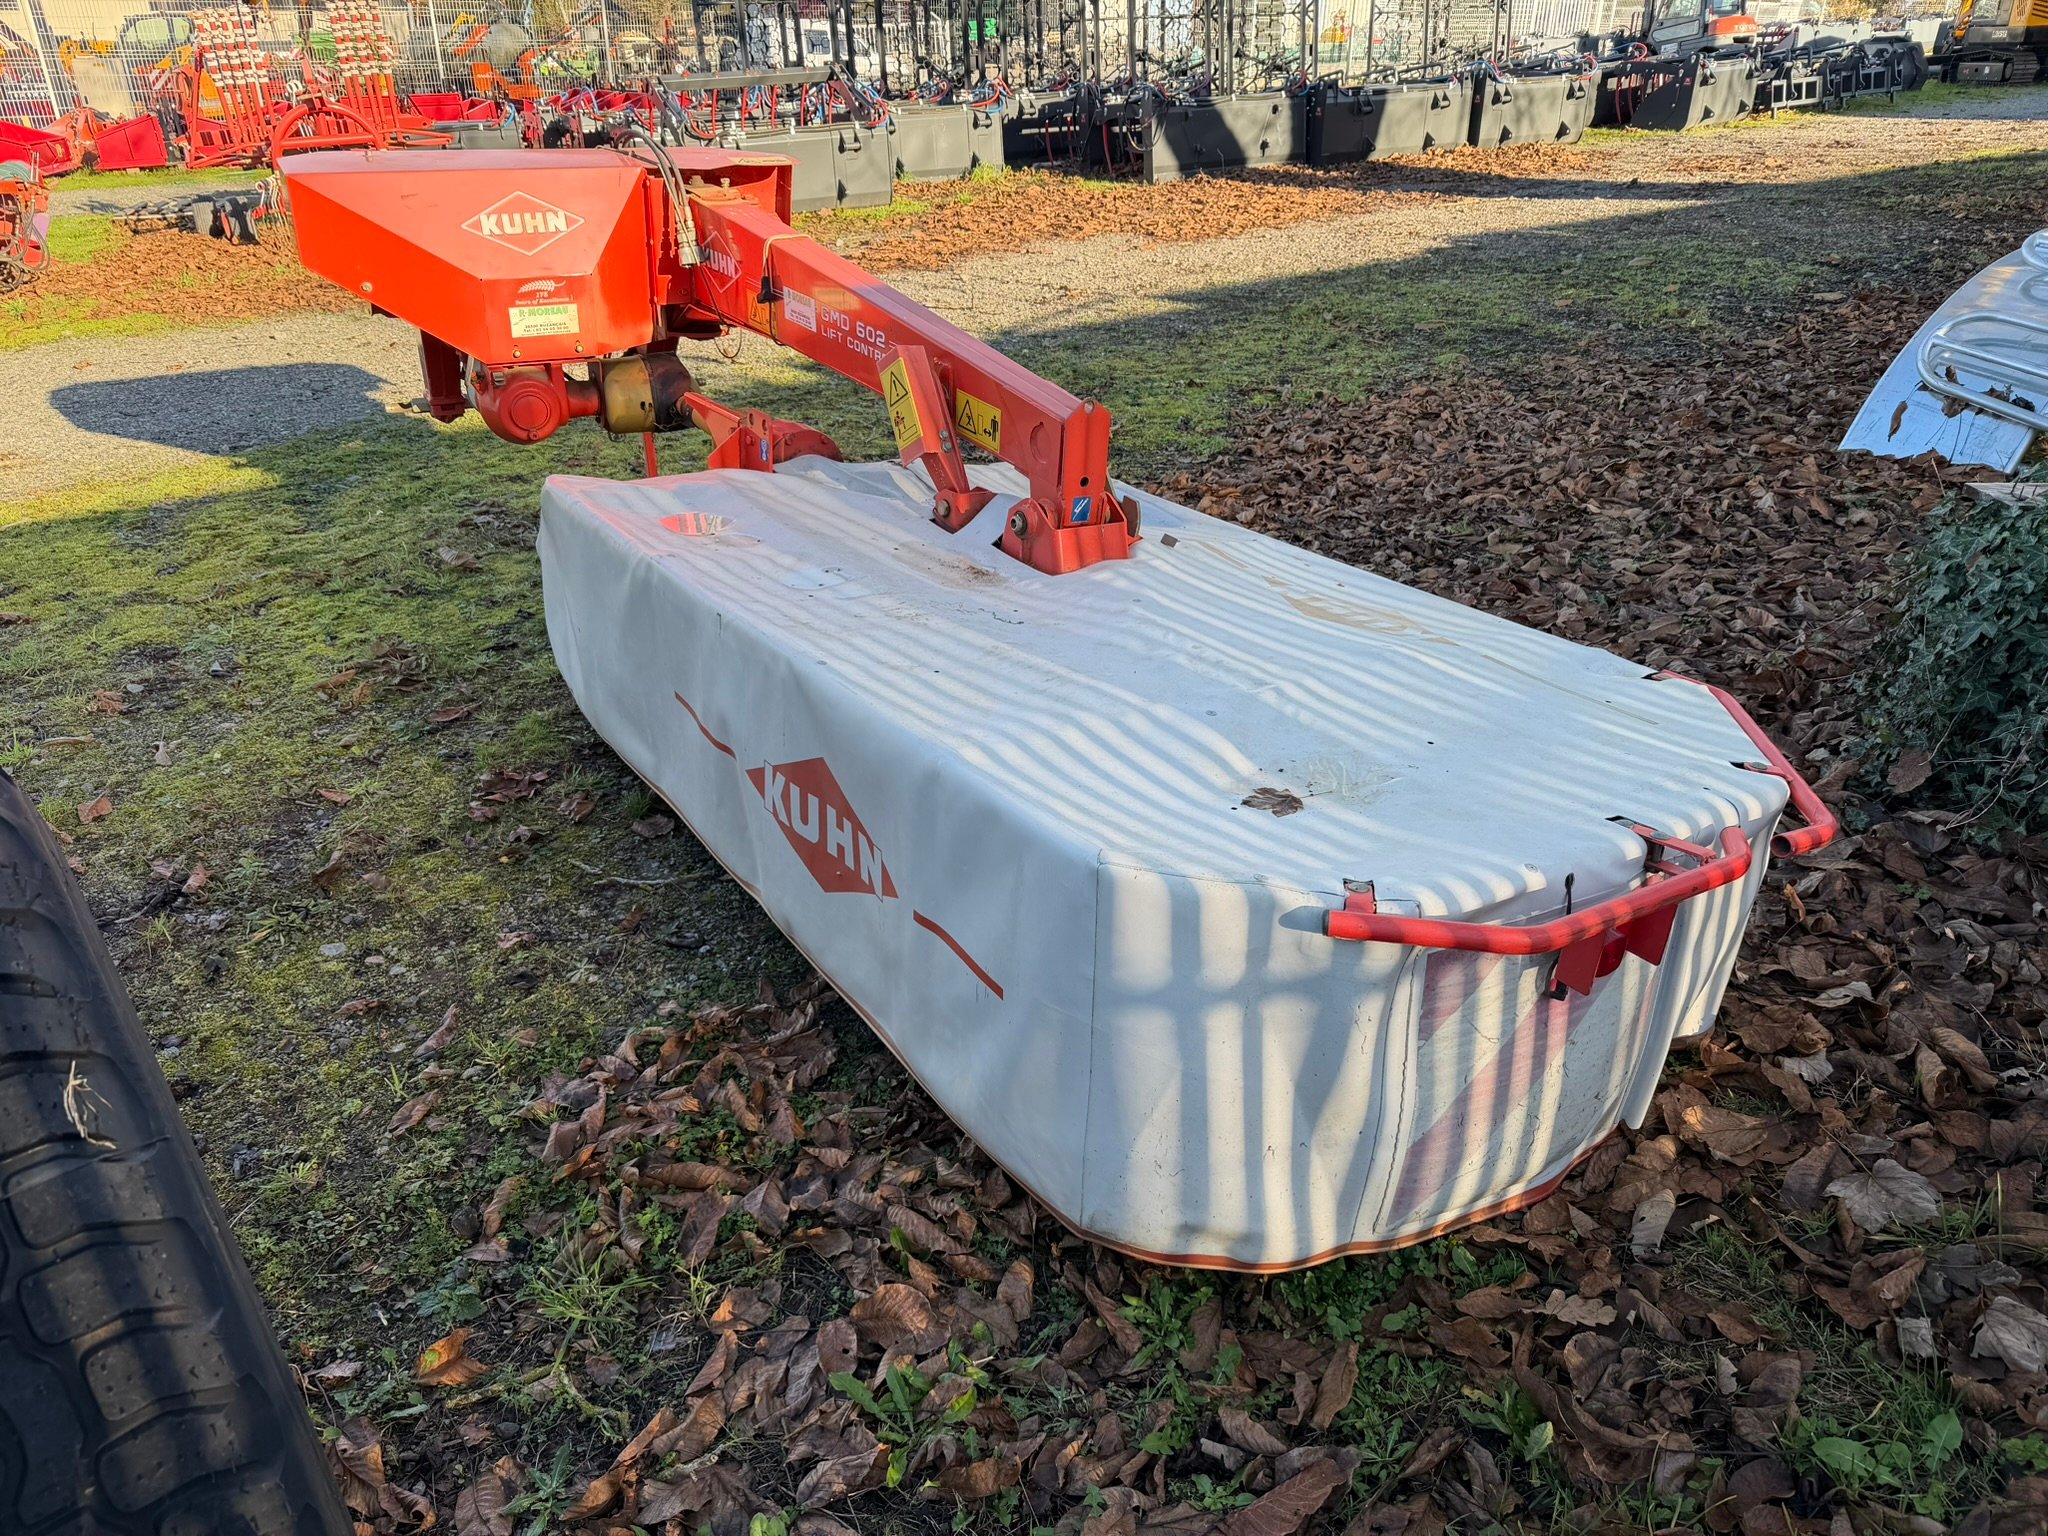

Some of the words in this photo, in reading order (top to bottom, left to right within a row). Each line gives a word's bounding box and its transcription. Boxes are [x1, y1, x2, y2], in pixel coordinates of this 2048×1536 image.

[478, 210, 568, 236] KUHN
[820, 306, 850, 332] GMD
[855, 321, 886, 348] 602
[820, 324, 843, 343] LIFT
[764, 760, 884, 903] KUHN
